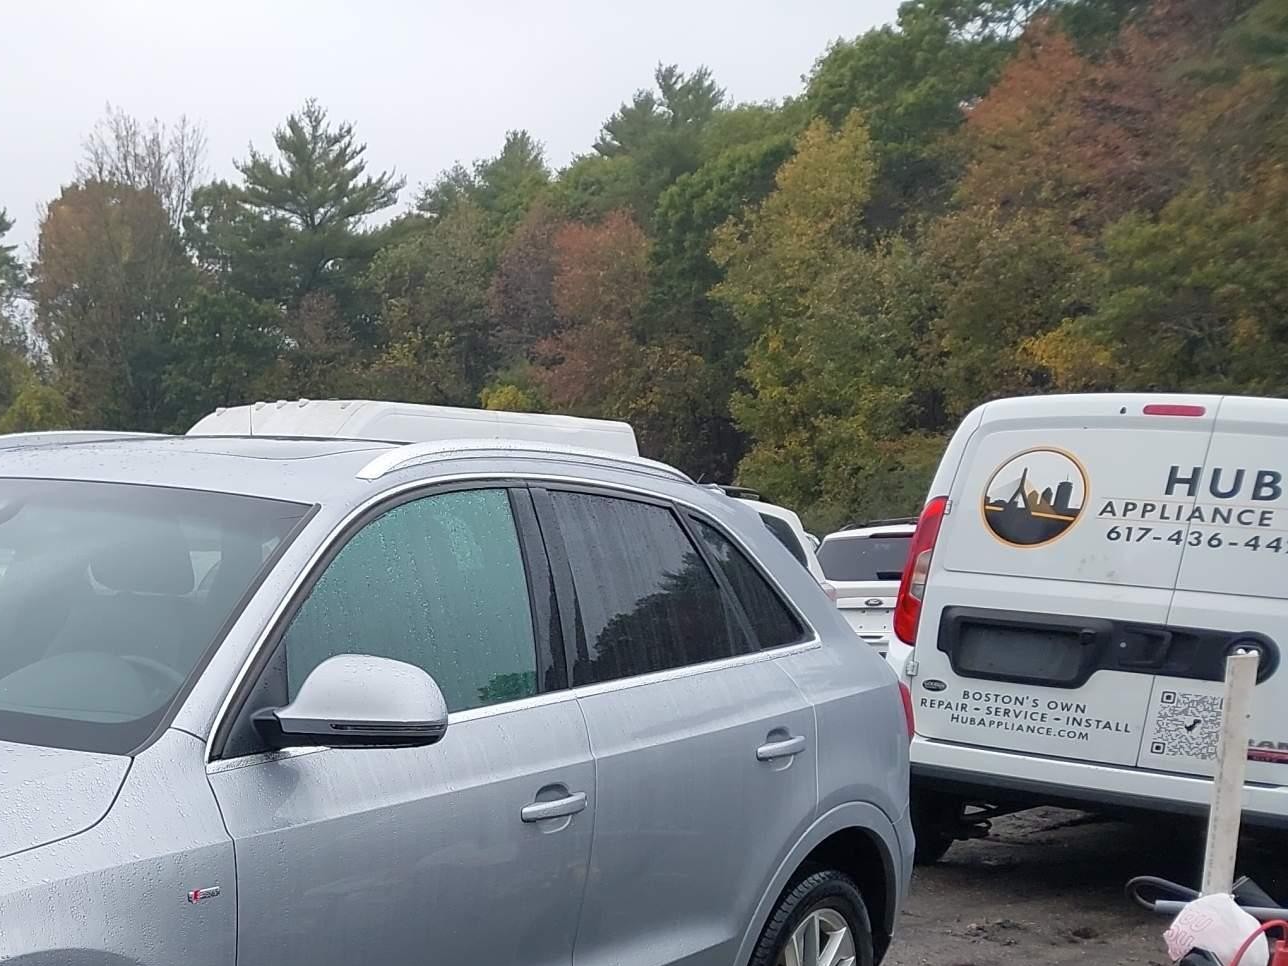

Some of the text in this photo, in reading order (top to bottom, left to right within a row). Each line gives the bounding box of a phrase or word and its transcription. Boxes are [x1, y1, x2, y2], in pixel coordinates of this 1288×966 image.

[1164, 465, 1283, 501] HUB
[1098, 500, 1274, 527] APPLIANCE
[1106, 525, 1288, 554] 617-436-44
[920, 698, 968, 713] REPAIR
[985, 706, 1048, 723] SERVICE
[1066, 716, 1131, 733] INSTALL
[962, 690, 1087, 714] BOSTON'S OWN
